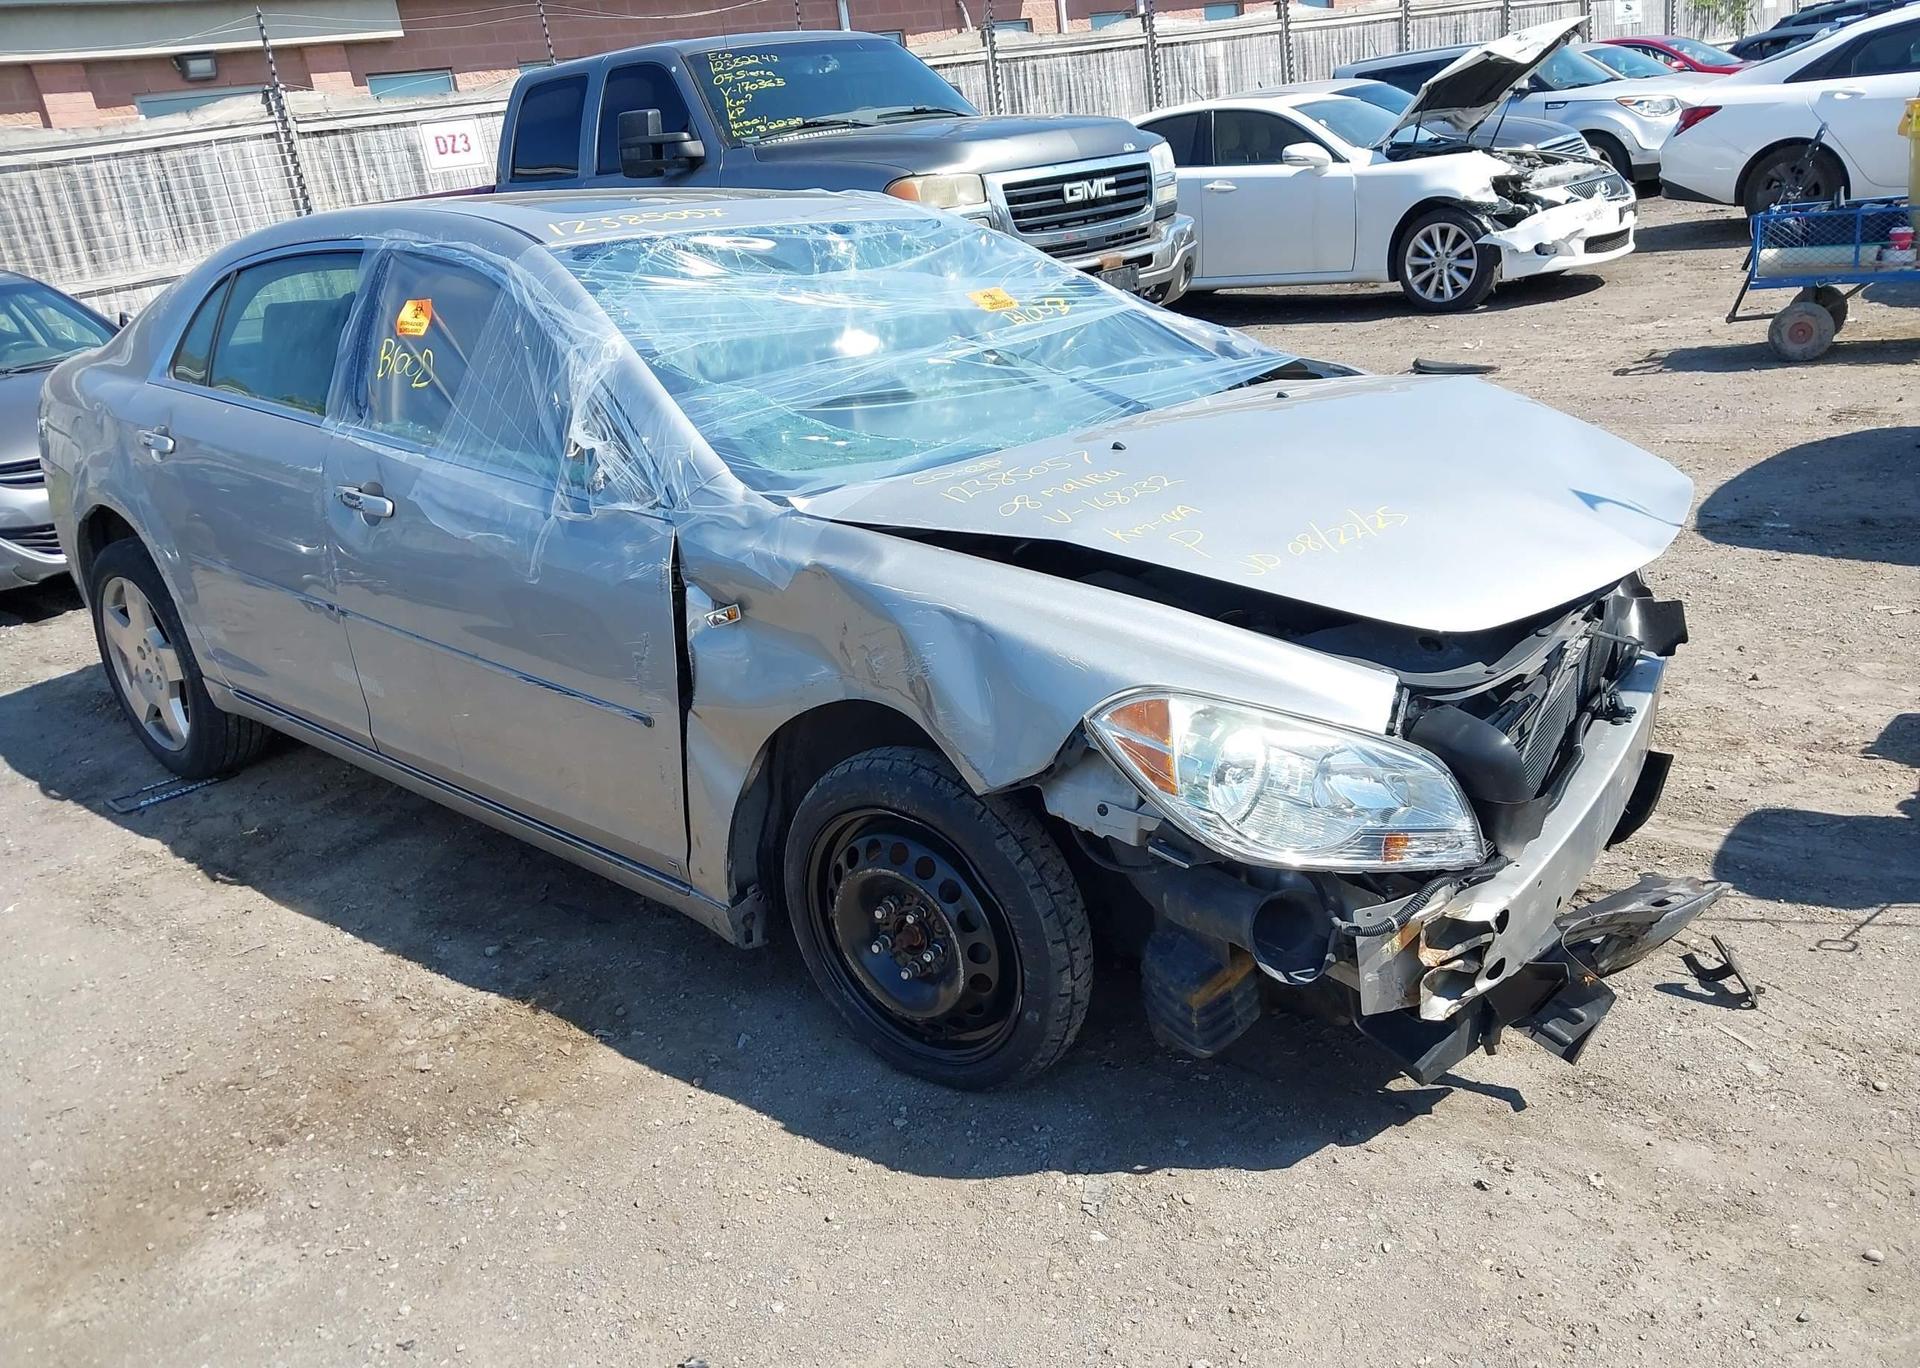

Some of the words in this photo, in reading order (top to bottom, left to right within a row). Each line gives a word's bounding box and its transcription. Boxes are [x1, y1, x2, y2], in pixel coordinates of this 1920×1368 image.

[434, 133, 472, 155] DZ3
[1063, 177, 1117, 204] GMC
[548, 208, 729, 237] 12385057
[940, 450, 1093, 503] 12385057
[999, 494, 1042, 517] 08
